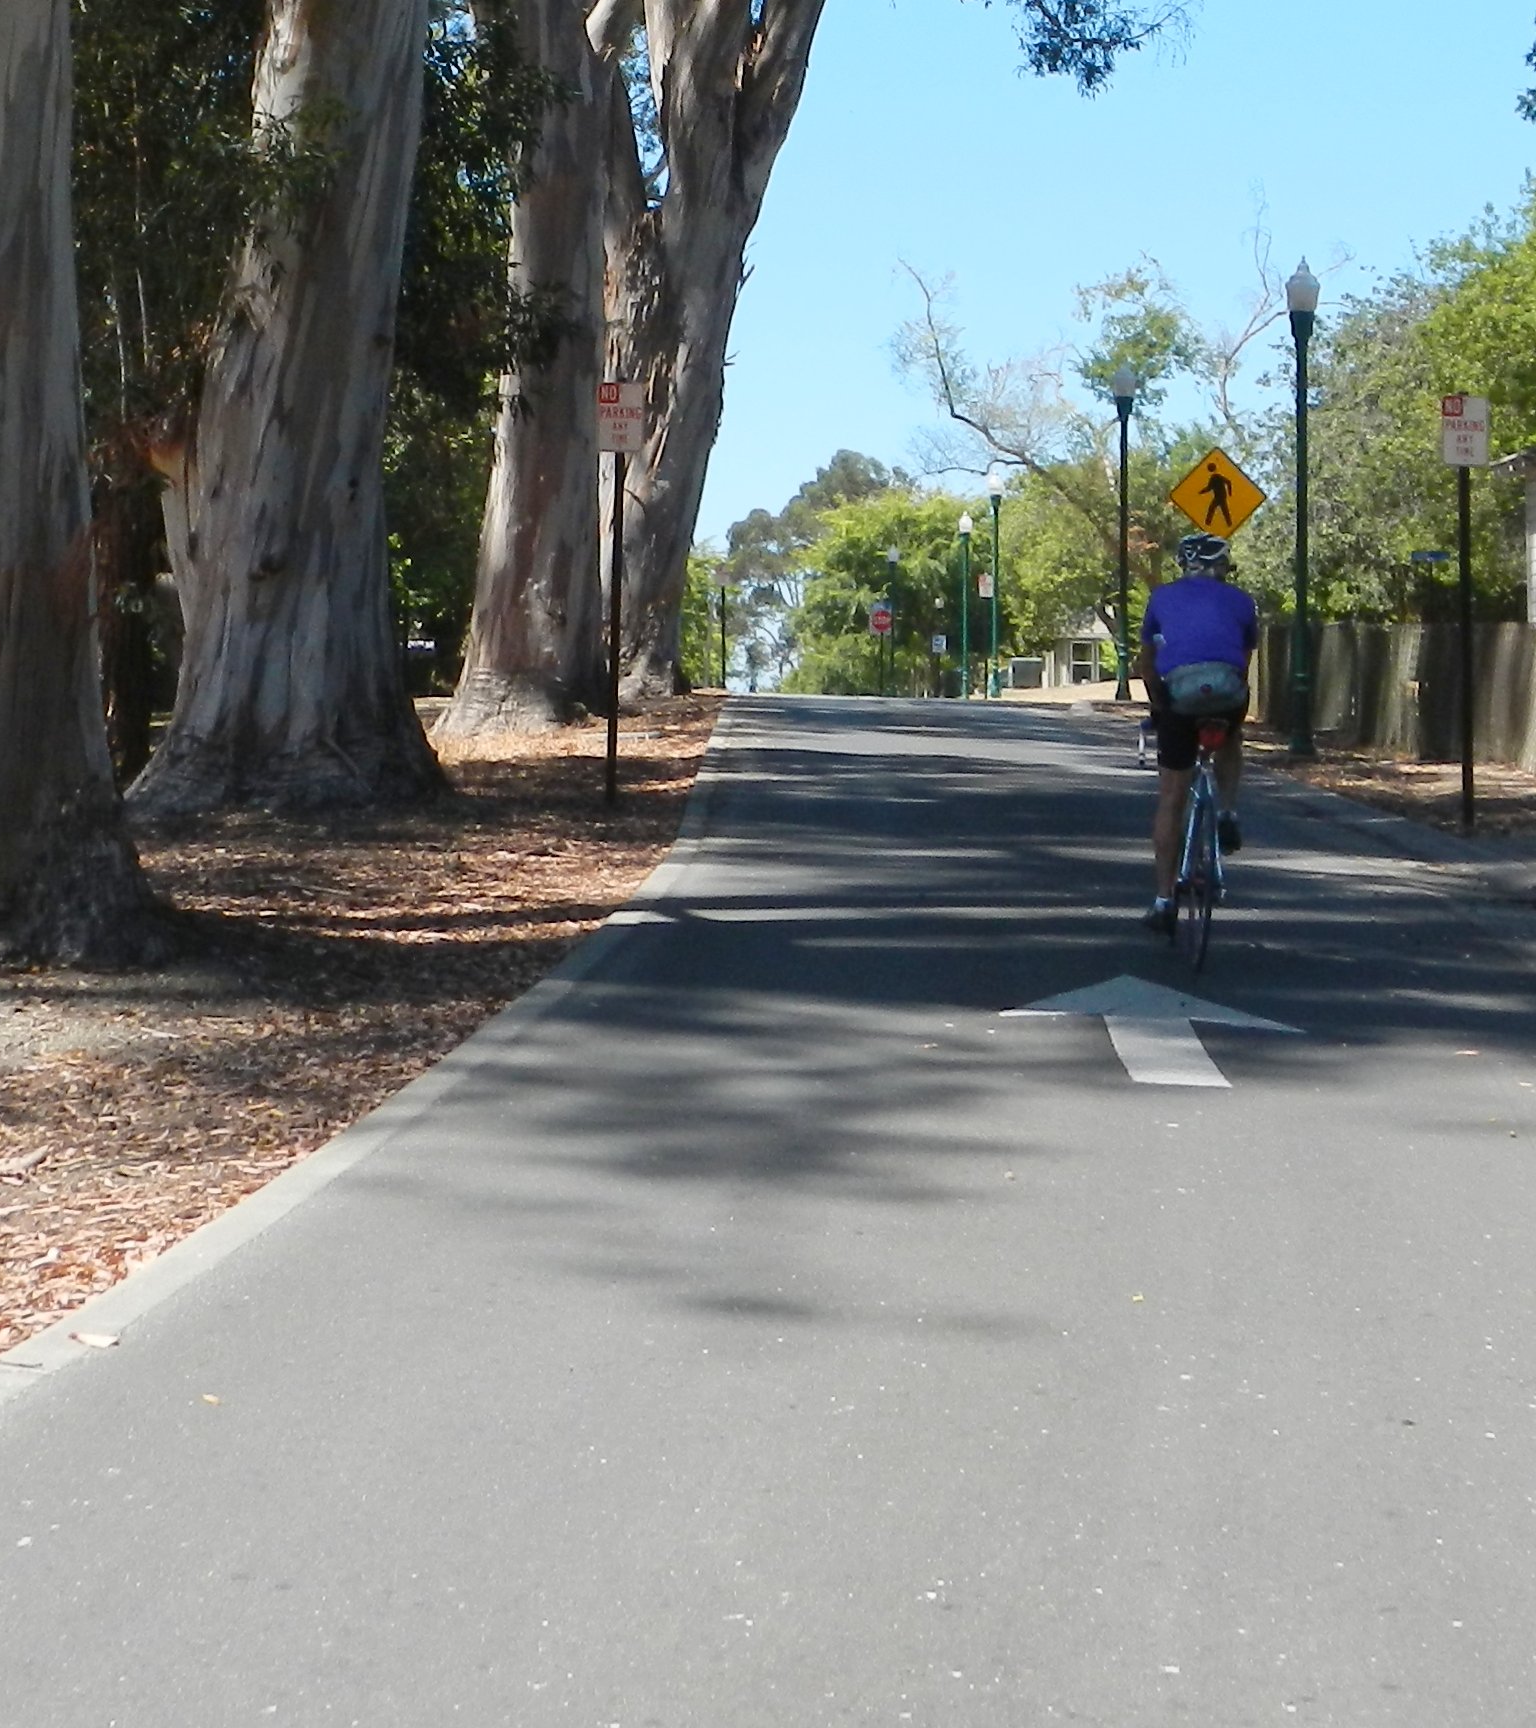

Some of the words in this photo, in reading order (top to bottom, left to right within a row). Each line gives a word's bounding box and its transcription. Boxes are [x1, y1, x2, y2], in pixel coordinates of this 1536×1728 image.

[600, 385, 617, 401] NO
[1445, 398, 1461, 413] NO
[600, 406, 642, 420] PARKING
[613, 422, 628, 430] ANY
[1444, 419, 1485, 432] PARKING
